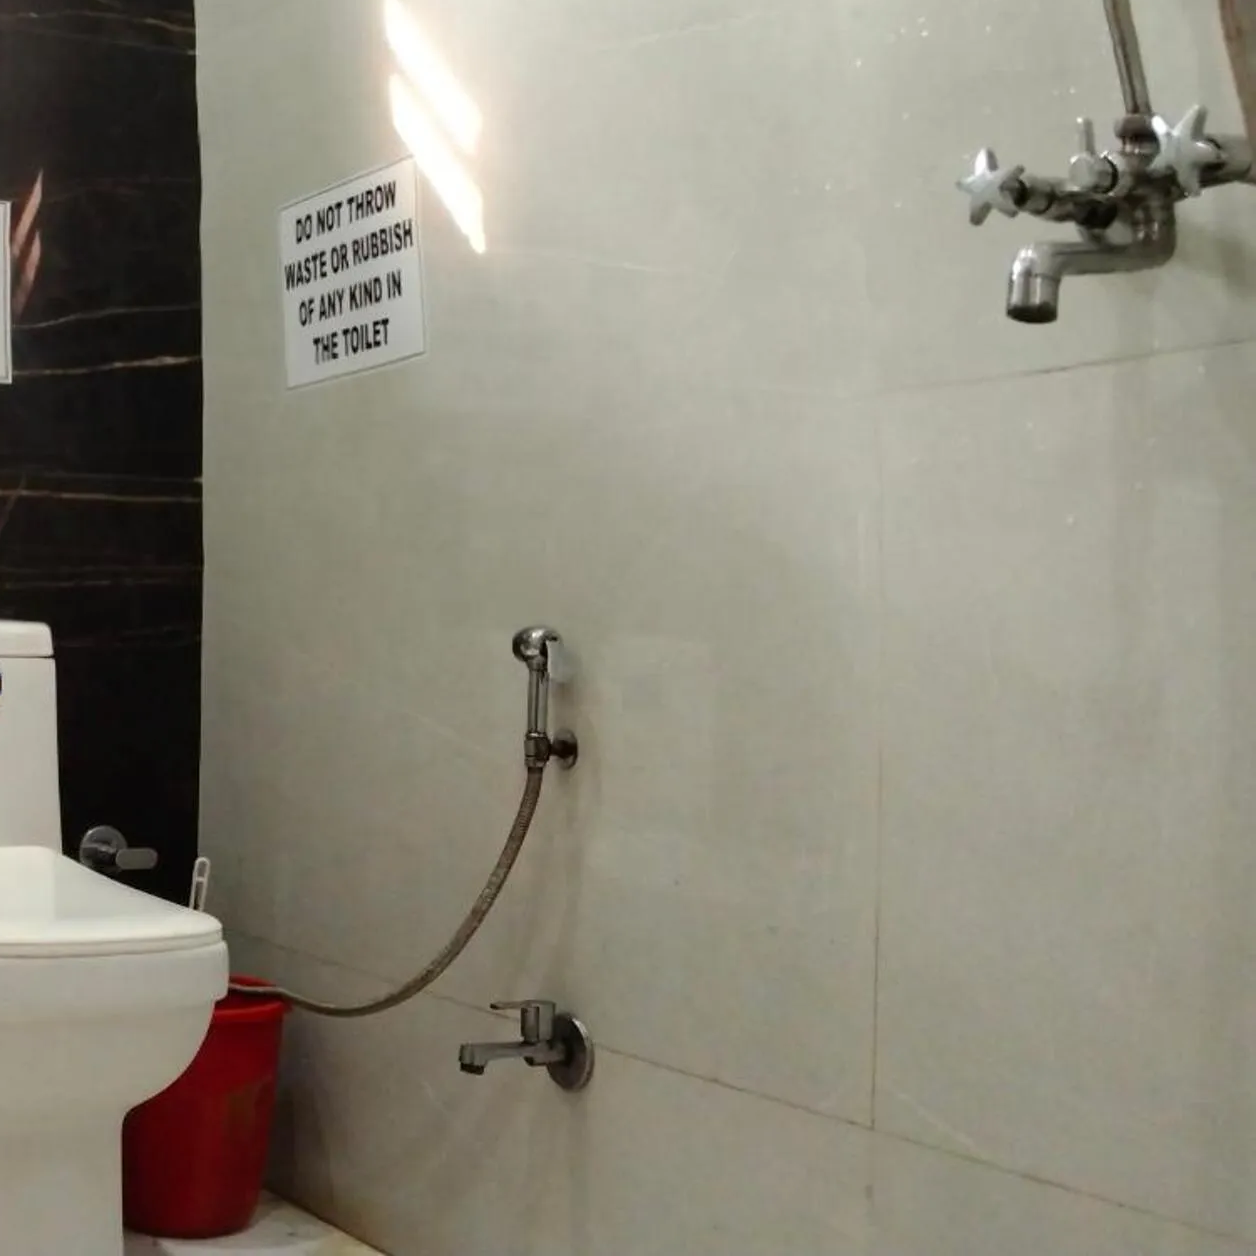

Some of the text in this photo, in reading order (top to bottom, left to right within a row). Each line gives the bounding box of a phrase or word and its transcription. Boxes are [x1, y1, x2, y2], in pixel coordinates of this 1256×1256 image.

[295, 181, 396, 244] DO NOT THROW
[285, 218, 413, 291] WASTE OR RUBBISH
[299, 269, 403, 326] OF ANY KIND IN
[313, 318, 390, 364] THE TOILET
